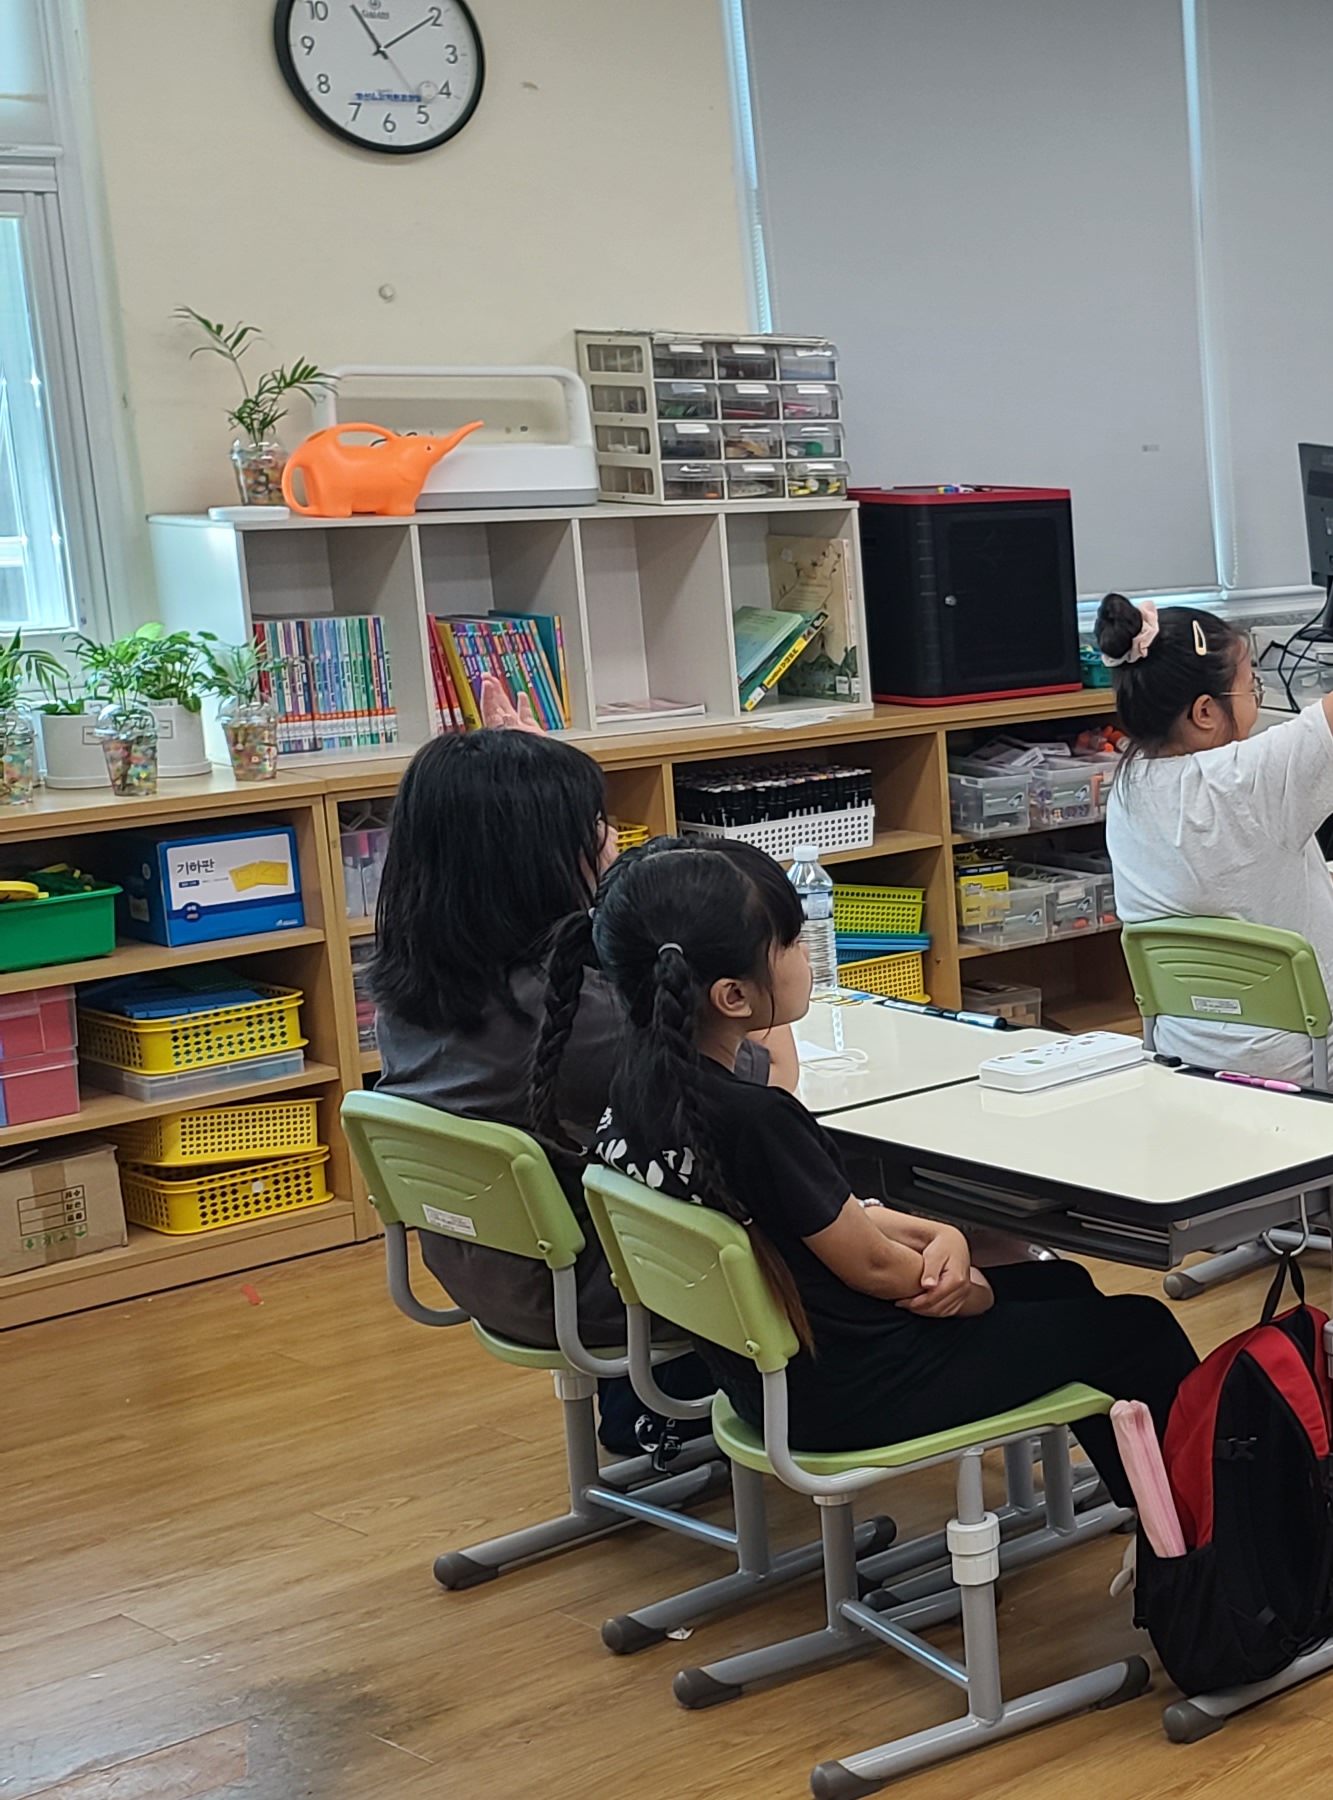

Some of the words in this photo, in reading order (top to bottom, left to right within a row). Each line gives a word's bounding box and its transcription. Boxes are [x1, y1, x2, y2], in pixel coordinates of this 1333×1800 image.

[304, 0, 328, 21] 10
[428, 6, 443, 27] 2
[301, 36, 315, 56] 9
[444, 44, 458, 64] 3
[316, 73, 331, 94] 8
[438, 80, 452, 99] 4
[348, 102, 362, 121] 7
[417, 105, 430, 125] 5
[383, 113, 396, 133] 6
[177, 858, 215, 875] 기하판
